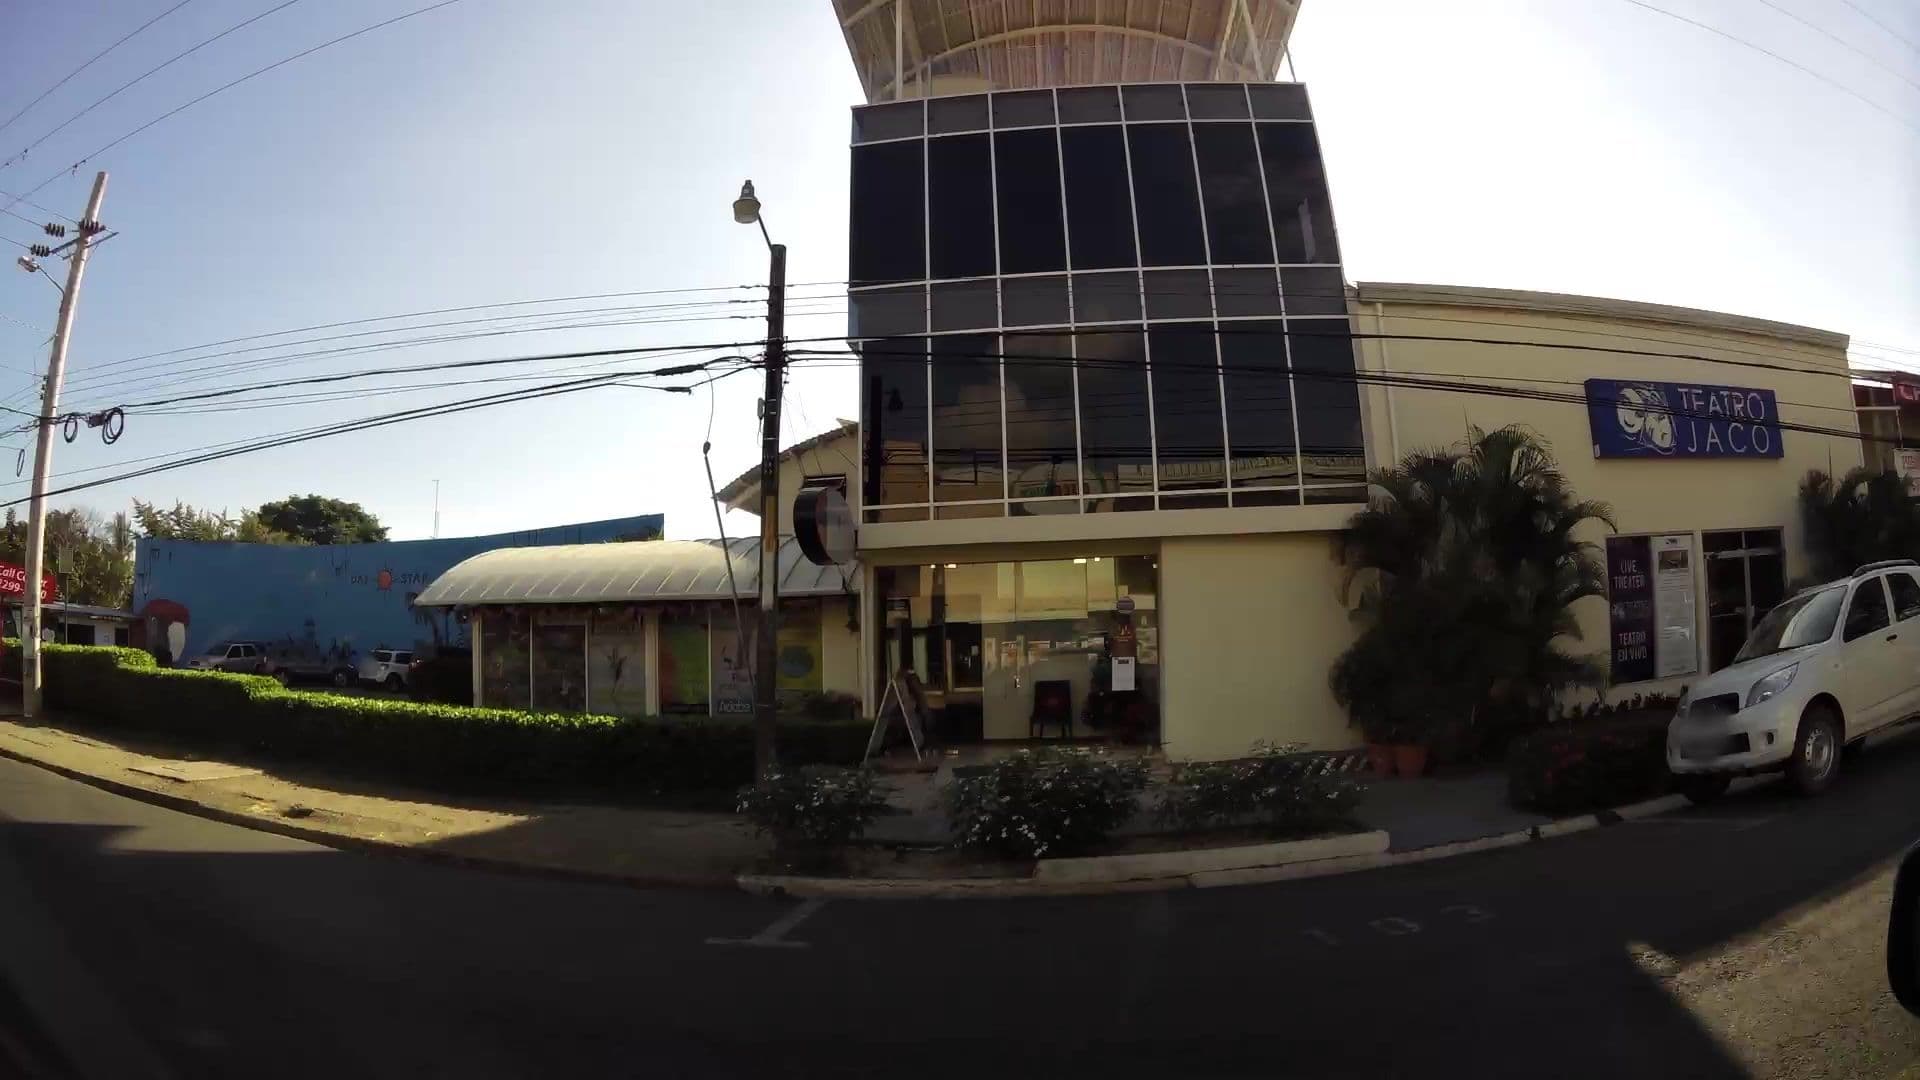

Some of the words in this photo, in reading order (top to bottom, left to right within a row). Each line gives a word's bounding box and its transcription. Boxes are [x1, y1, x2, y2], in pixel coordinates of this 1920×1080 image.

[1676, 387, 1764, 420] TEATRO
[1687, 421, 1770, 454] JACO
[1620, 559, 1639, 575] LIVE
[1613, 575, 1647, 590] THEATER
[1618, 631, 1647, 646] TEATRO
[1629, 646, 1648, 661] VIVO
